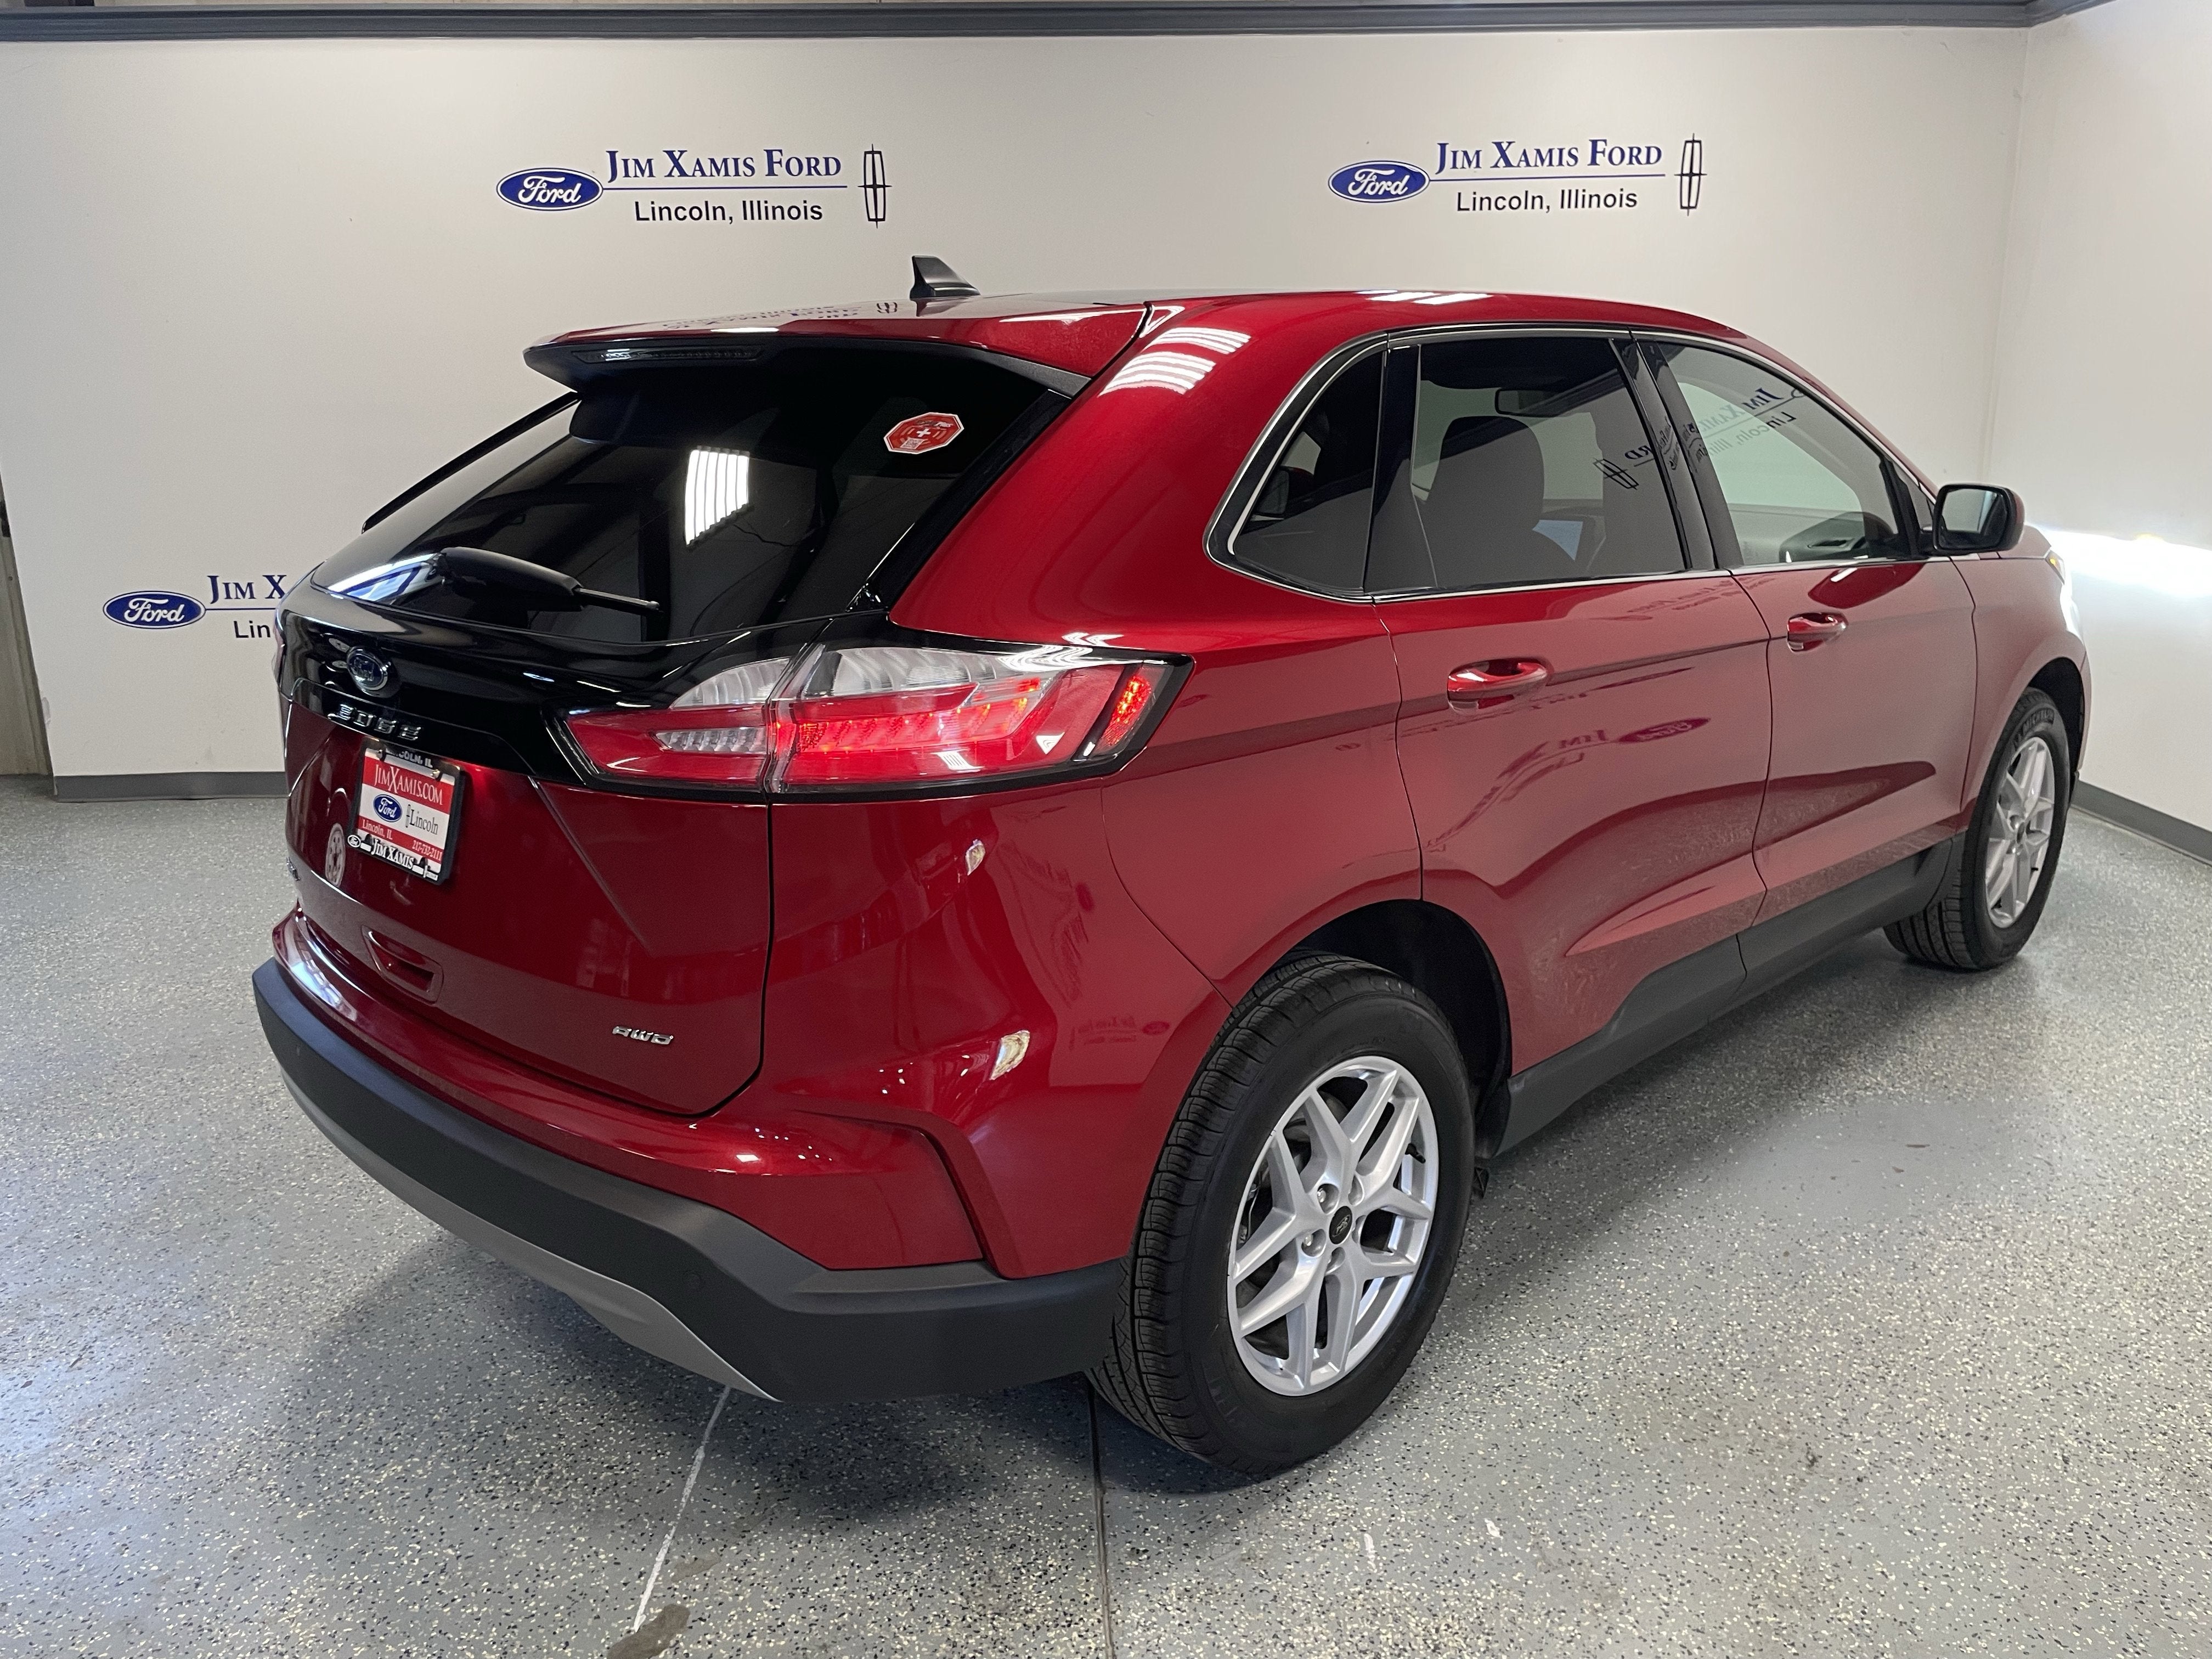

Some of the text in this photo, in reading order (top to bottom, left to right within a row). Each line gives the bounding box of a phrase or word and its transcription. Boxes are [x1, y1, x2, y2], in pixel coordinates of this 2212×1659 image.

[606, 149, 842, 183] JIM XAMIS FORD
[1436, 139, 1663, 175] JIM XAMIS FORD
[518, 176, 582, 204] Ford
[1347, 169, 1409, 196] Ford
[635, 200, 823, 225] Lincoln, Illinois
[1457, 188, 1638, 214] Lincoln, Illinois
[206, 575, 256, 605] JIM
[124, 598, 185, 622] Ford
[338, 704, 421, 741] EDGE
[374, 764, 443, 805] JIMXAMIS.COM
[377, 798, 397, 818] Ford
[410, 809, 438, 835] Lincoln
[386, 847, 414, 869] XAMIS
[612, 1026, 674, 1045] AWD
